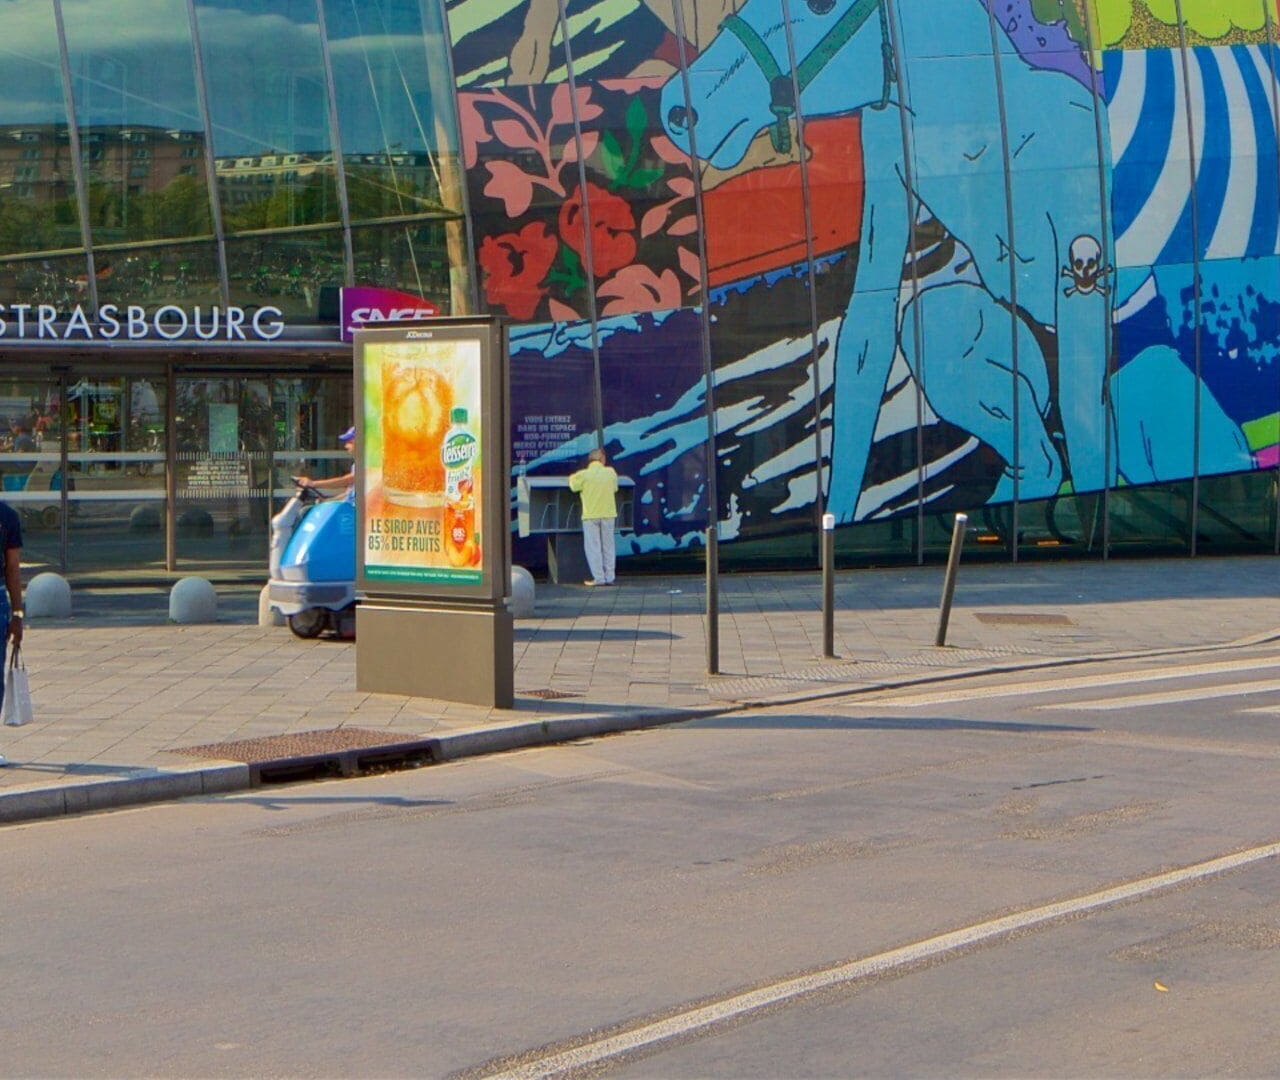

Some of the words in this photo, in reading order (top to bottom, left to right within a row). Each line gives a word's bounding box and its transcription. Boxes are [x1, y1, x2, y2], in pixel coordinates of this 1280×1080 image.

[371, 519, 382, 534] LE
[384, 519, 414, 534] SIROP
[415, 521, 441, 535] AVEC
[368, 535, 390, 550] 85%
[391, 536, 405, 551] DE
[406, 536, 441, 553] FRUITS
